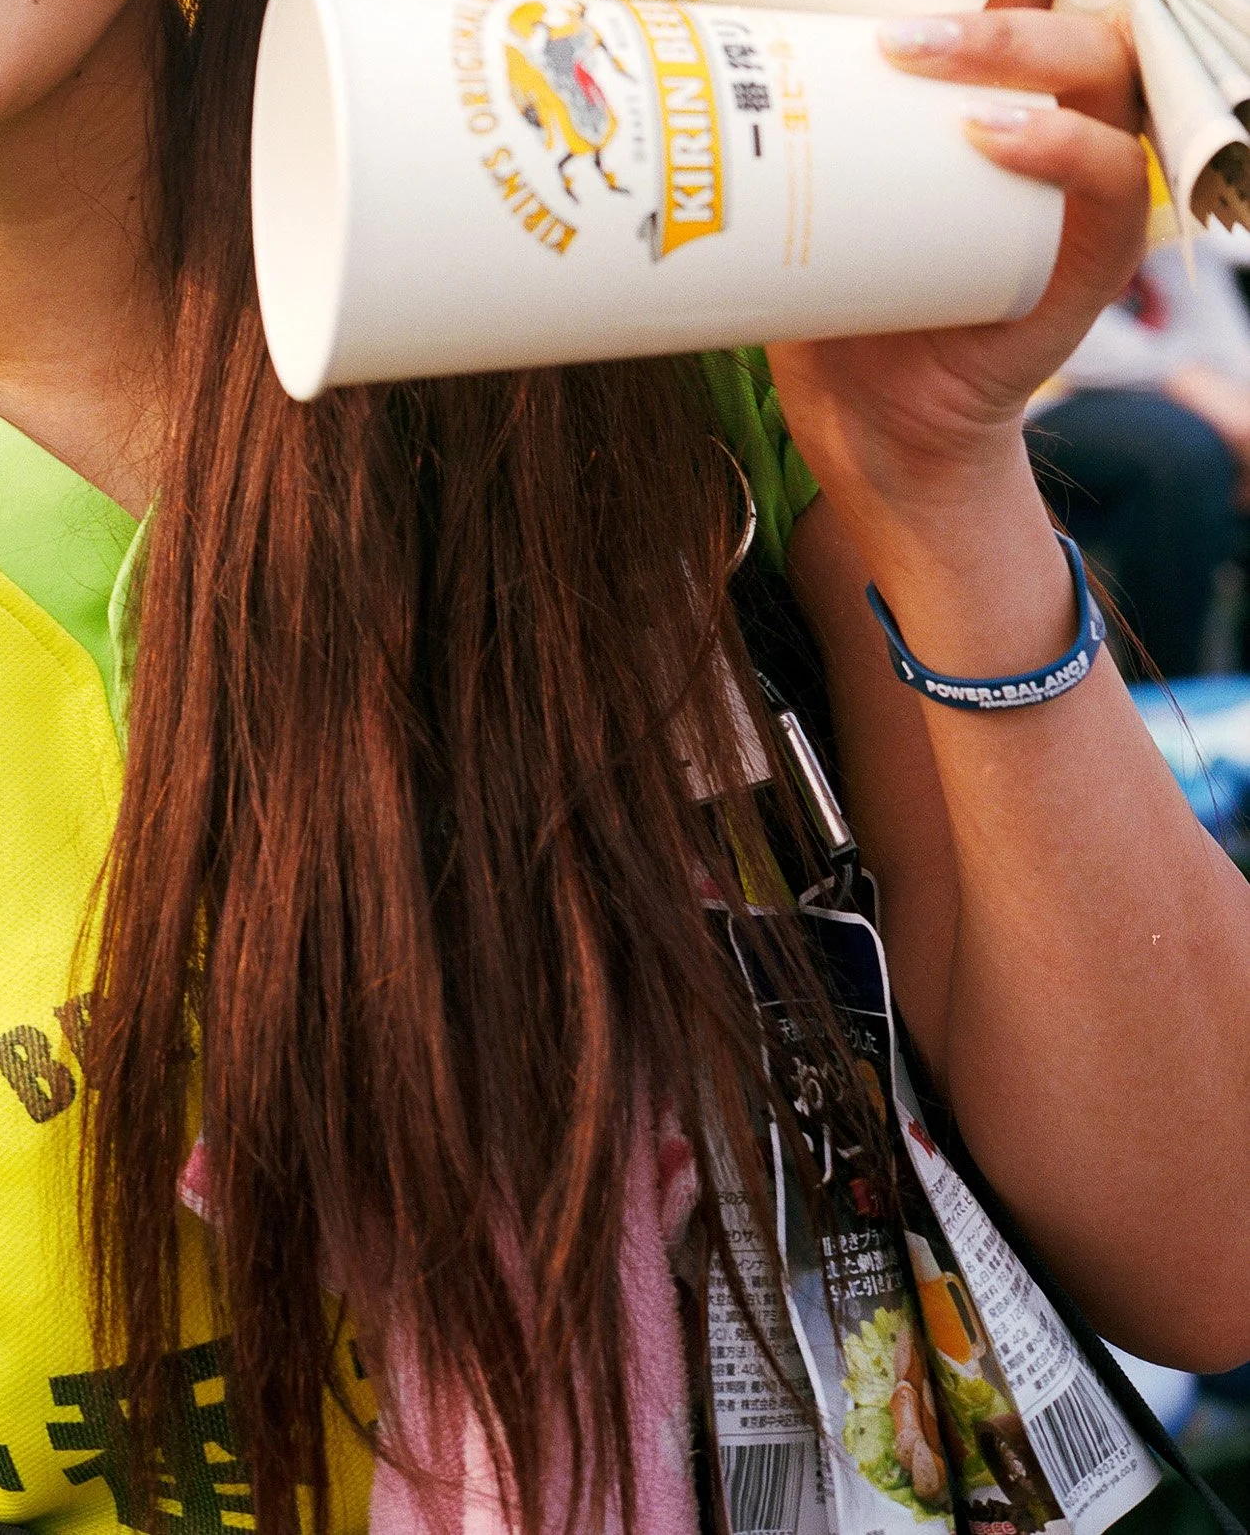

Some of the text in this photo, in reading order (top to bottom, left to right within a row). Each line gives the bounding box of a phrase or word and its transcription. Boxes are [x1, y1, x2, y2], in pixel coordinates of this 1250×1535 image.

[662, 76, 714, 222] KIRIN
[925, 679, 993, 702] POWER
[1001, 650, 1090, 701] BALANCE
